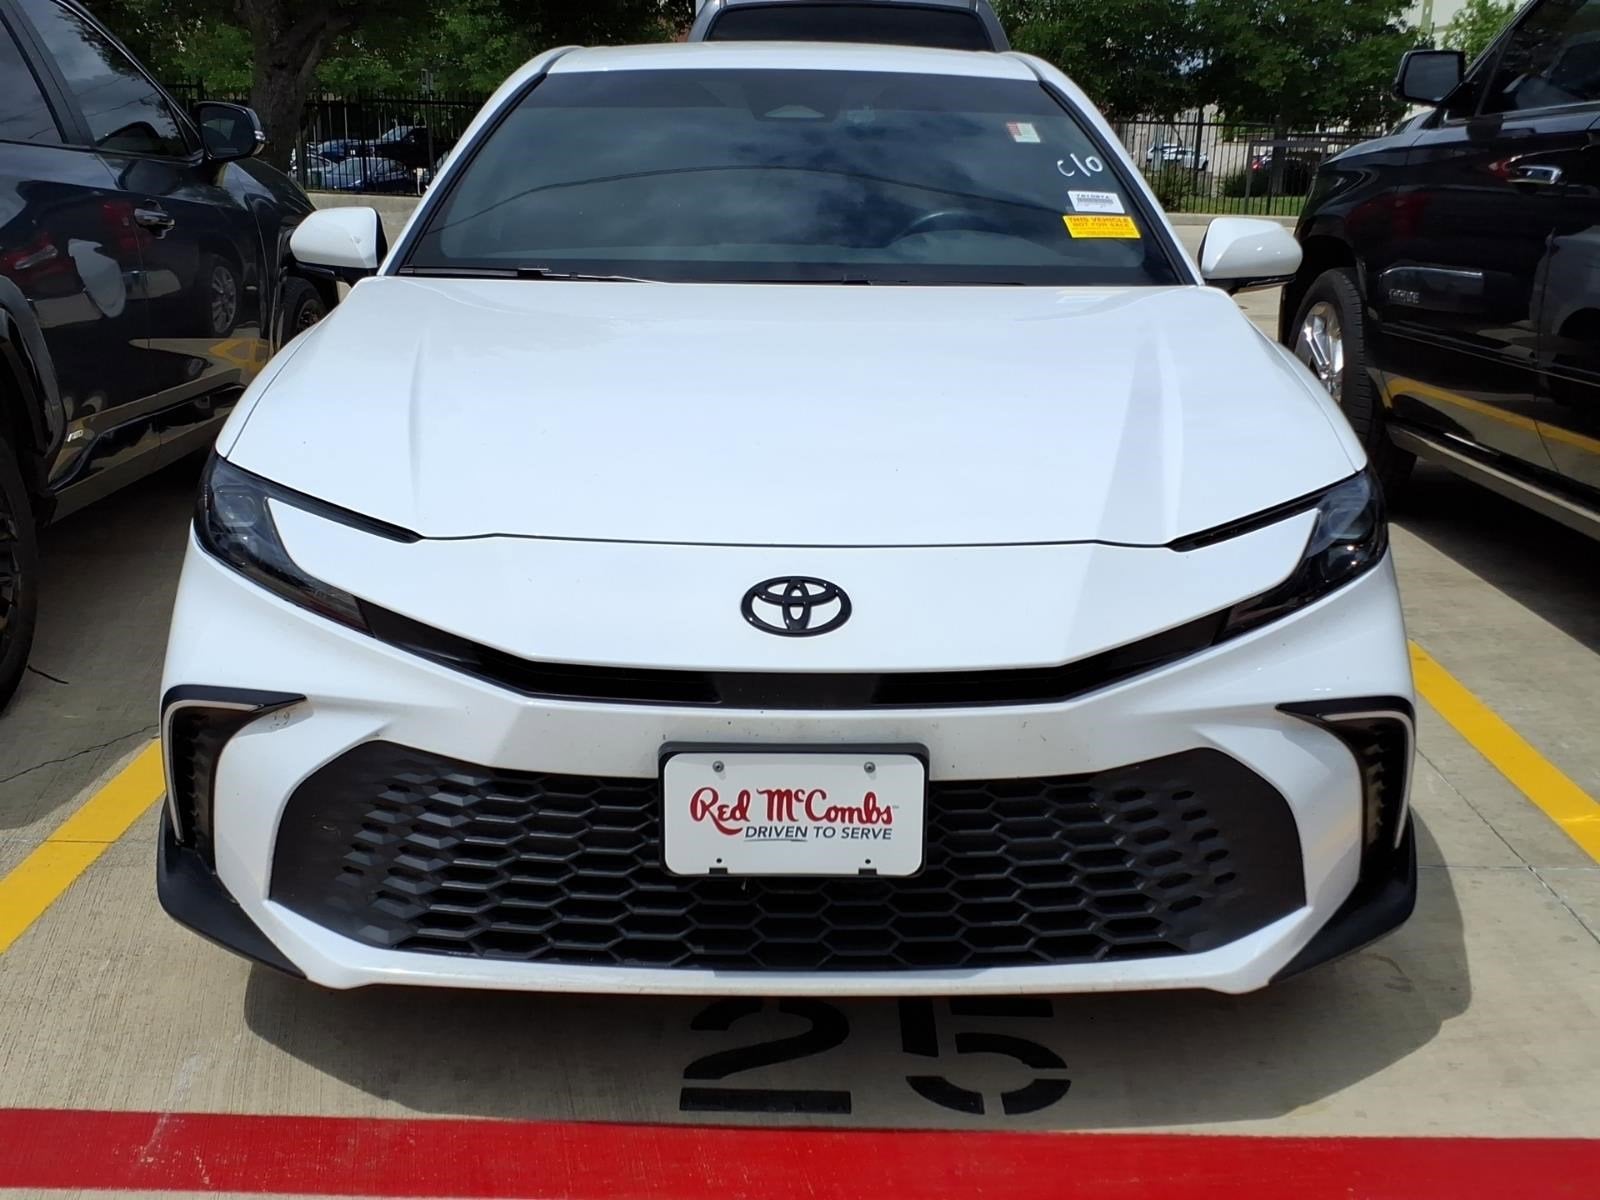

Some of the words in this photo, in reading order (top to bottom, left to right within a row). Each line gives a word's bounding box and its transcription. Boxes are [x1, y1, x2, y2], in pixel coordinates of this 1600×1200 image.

[690, 787, 751, 836] Red
[756, 788, 893, 825] McCombs
[744, 825, 808, 839] DRIVEN
[814, 826, 836, 839] TO
[841, 827, 892, 840] SERVE
[680, 996, 1071, 1114] 25
